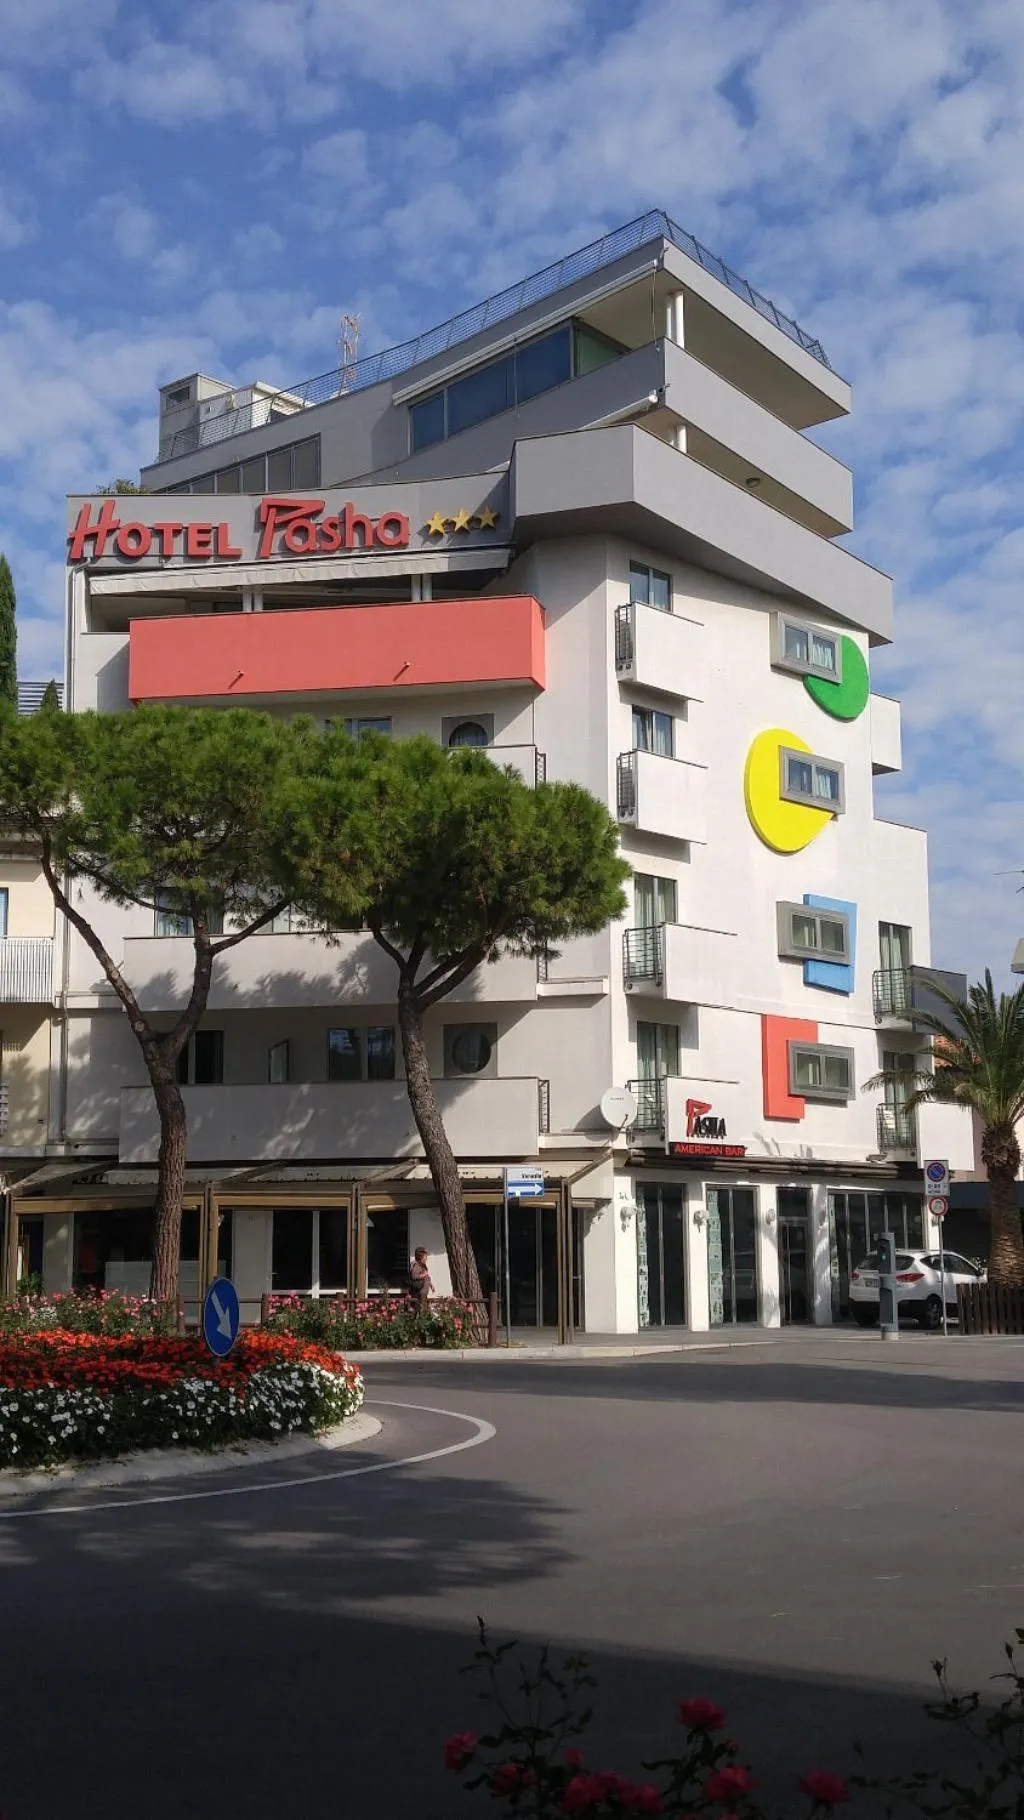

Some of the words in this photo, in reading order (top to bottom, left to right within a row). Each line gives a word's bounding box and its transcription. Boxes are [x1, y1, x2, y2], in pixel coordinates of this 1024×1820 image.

[69, 500, 243, 560] HOTEL
[259, 498, 410, 559] Pasha
[674, 1143, 723, 1155] AMERICAN
[725, 1146, 744, 1157] BAR
